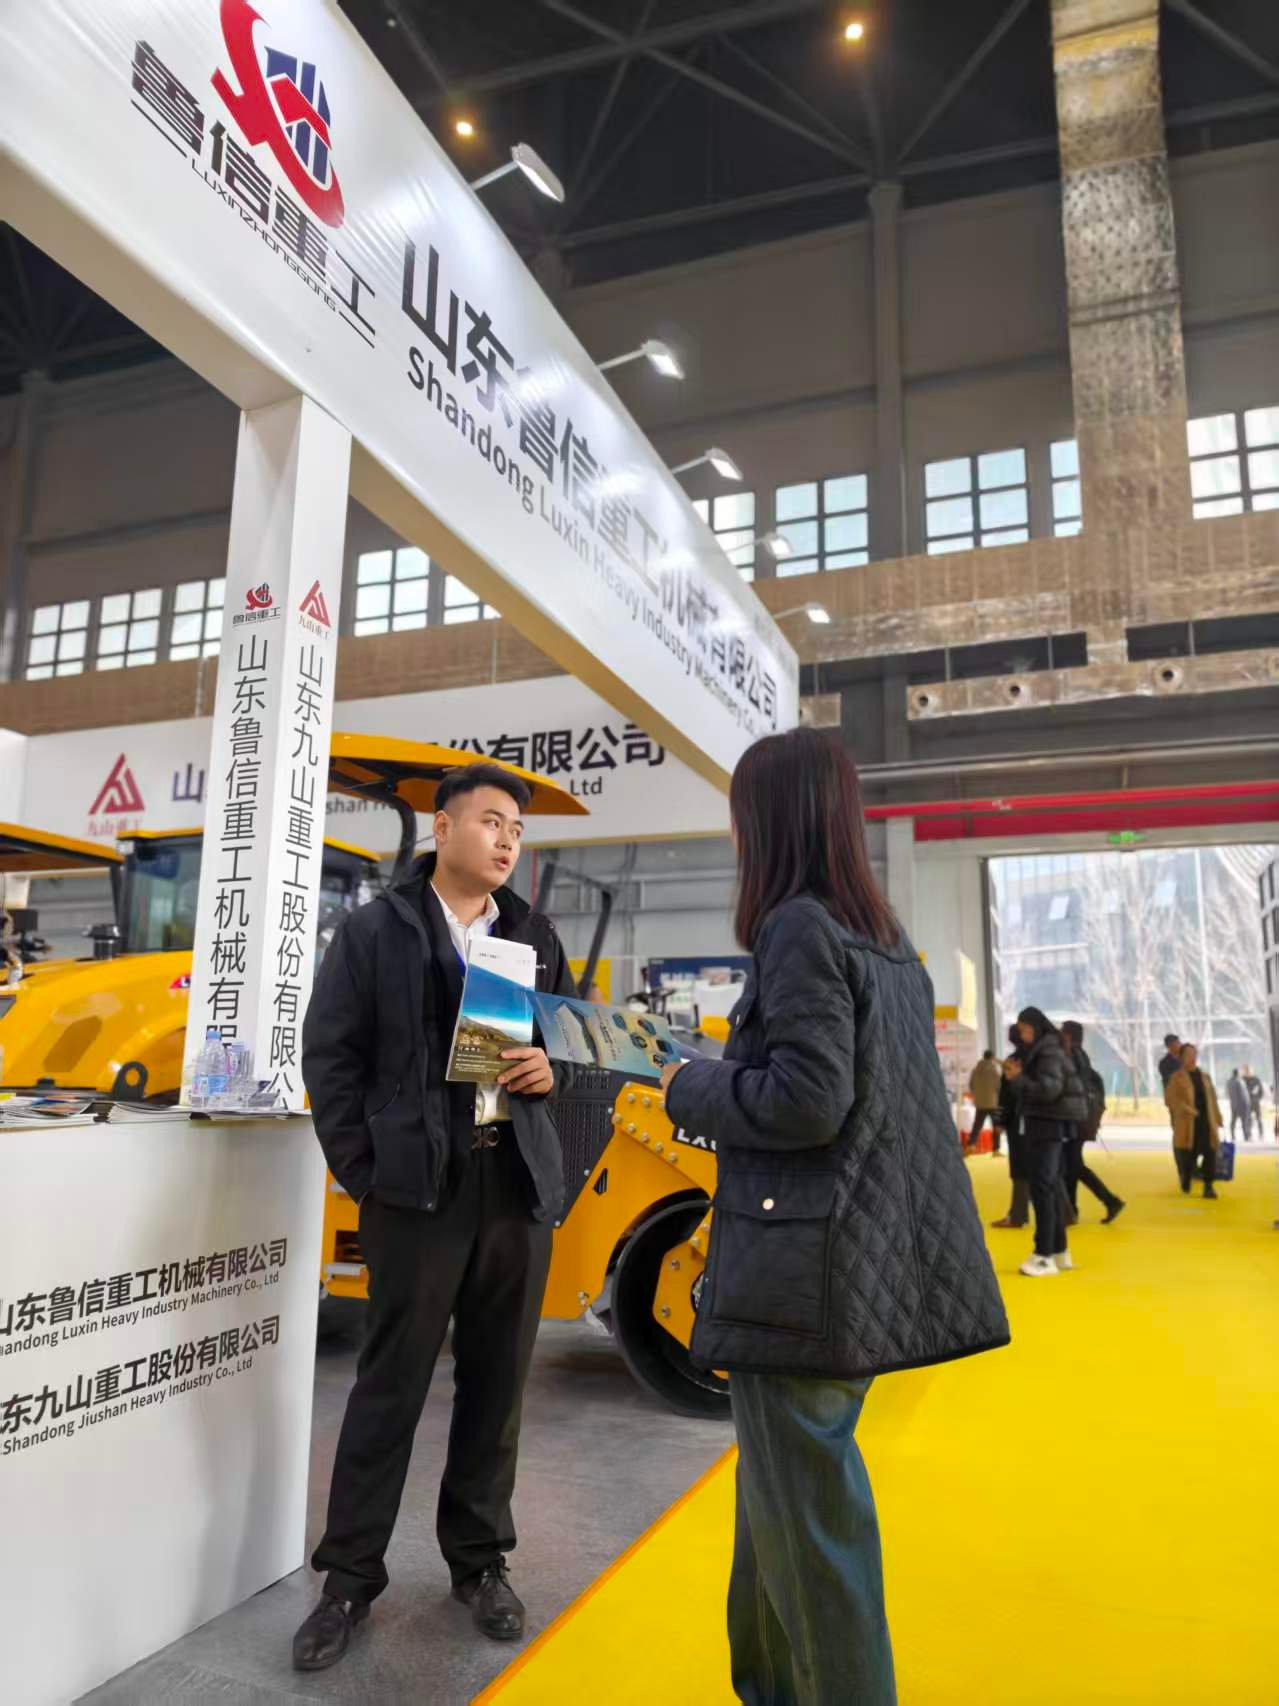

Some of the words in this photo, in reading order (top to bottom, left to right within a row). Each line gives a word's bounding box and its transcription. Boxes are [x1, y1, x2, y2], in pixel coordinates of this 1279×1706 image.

[408, 345, 534, 516] Shandong
[540, 484, 590, 566] Luxin
[642, 596, 692, 676] Industry
[570, 777, 603, 796] Ltd
[62, 1320, 98, 1340] Luxin
[101, 1309, 139, 1331] Heavy
[142, 1295, 188, 1319] Industry
[191, 1280, 243, 1306] Machinery
[264, 1272, 279, 1286] Ltd
[3, 1420, 75, 1456] Shandong
[78, 1402, 127, 1430] Jiushan
[130, 1389, 166, 1412] Heavy
[169, 1371, 213, 1398] Industry
[236, 1356, 252, 1373] Ltd
